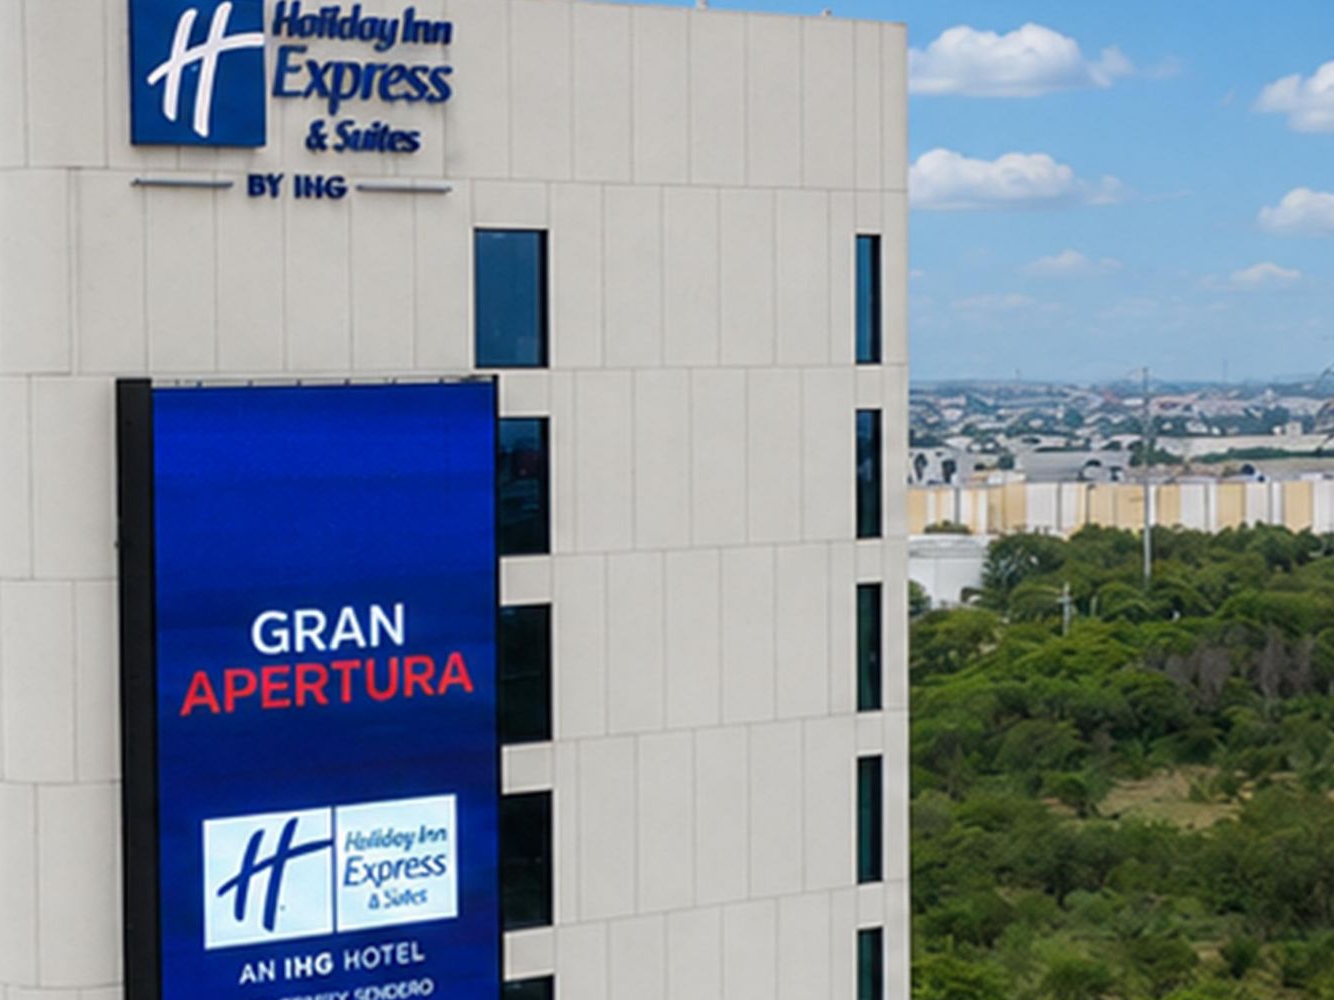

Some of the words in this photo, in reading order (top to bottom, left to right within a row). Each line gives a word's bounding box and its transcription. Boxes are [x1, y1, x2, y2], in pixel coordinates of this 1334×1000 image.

[271, 0, 399, 52] Holiday
[401, 6, 453, 45] Inn
[271, 44, 453, 117] Express
[305, 119, 328, 151] &
[333, 119, 421, 153] Suites
[247, 172, 284, 199] BY
[251, 603, 404, 654] GRAN
[180, 652, 474, 716] APERTURA
[345, 827, 416, 852] Holiday
[418, 825, 447, 844] Inn
[344, 854, 447, 888] Express
[239, 959, 275, 985] AN
[285, 952, 334, 980] IHG
[344, 940, 425, 972] HOTEL
